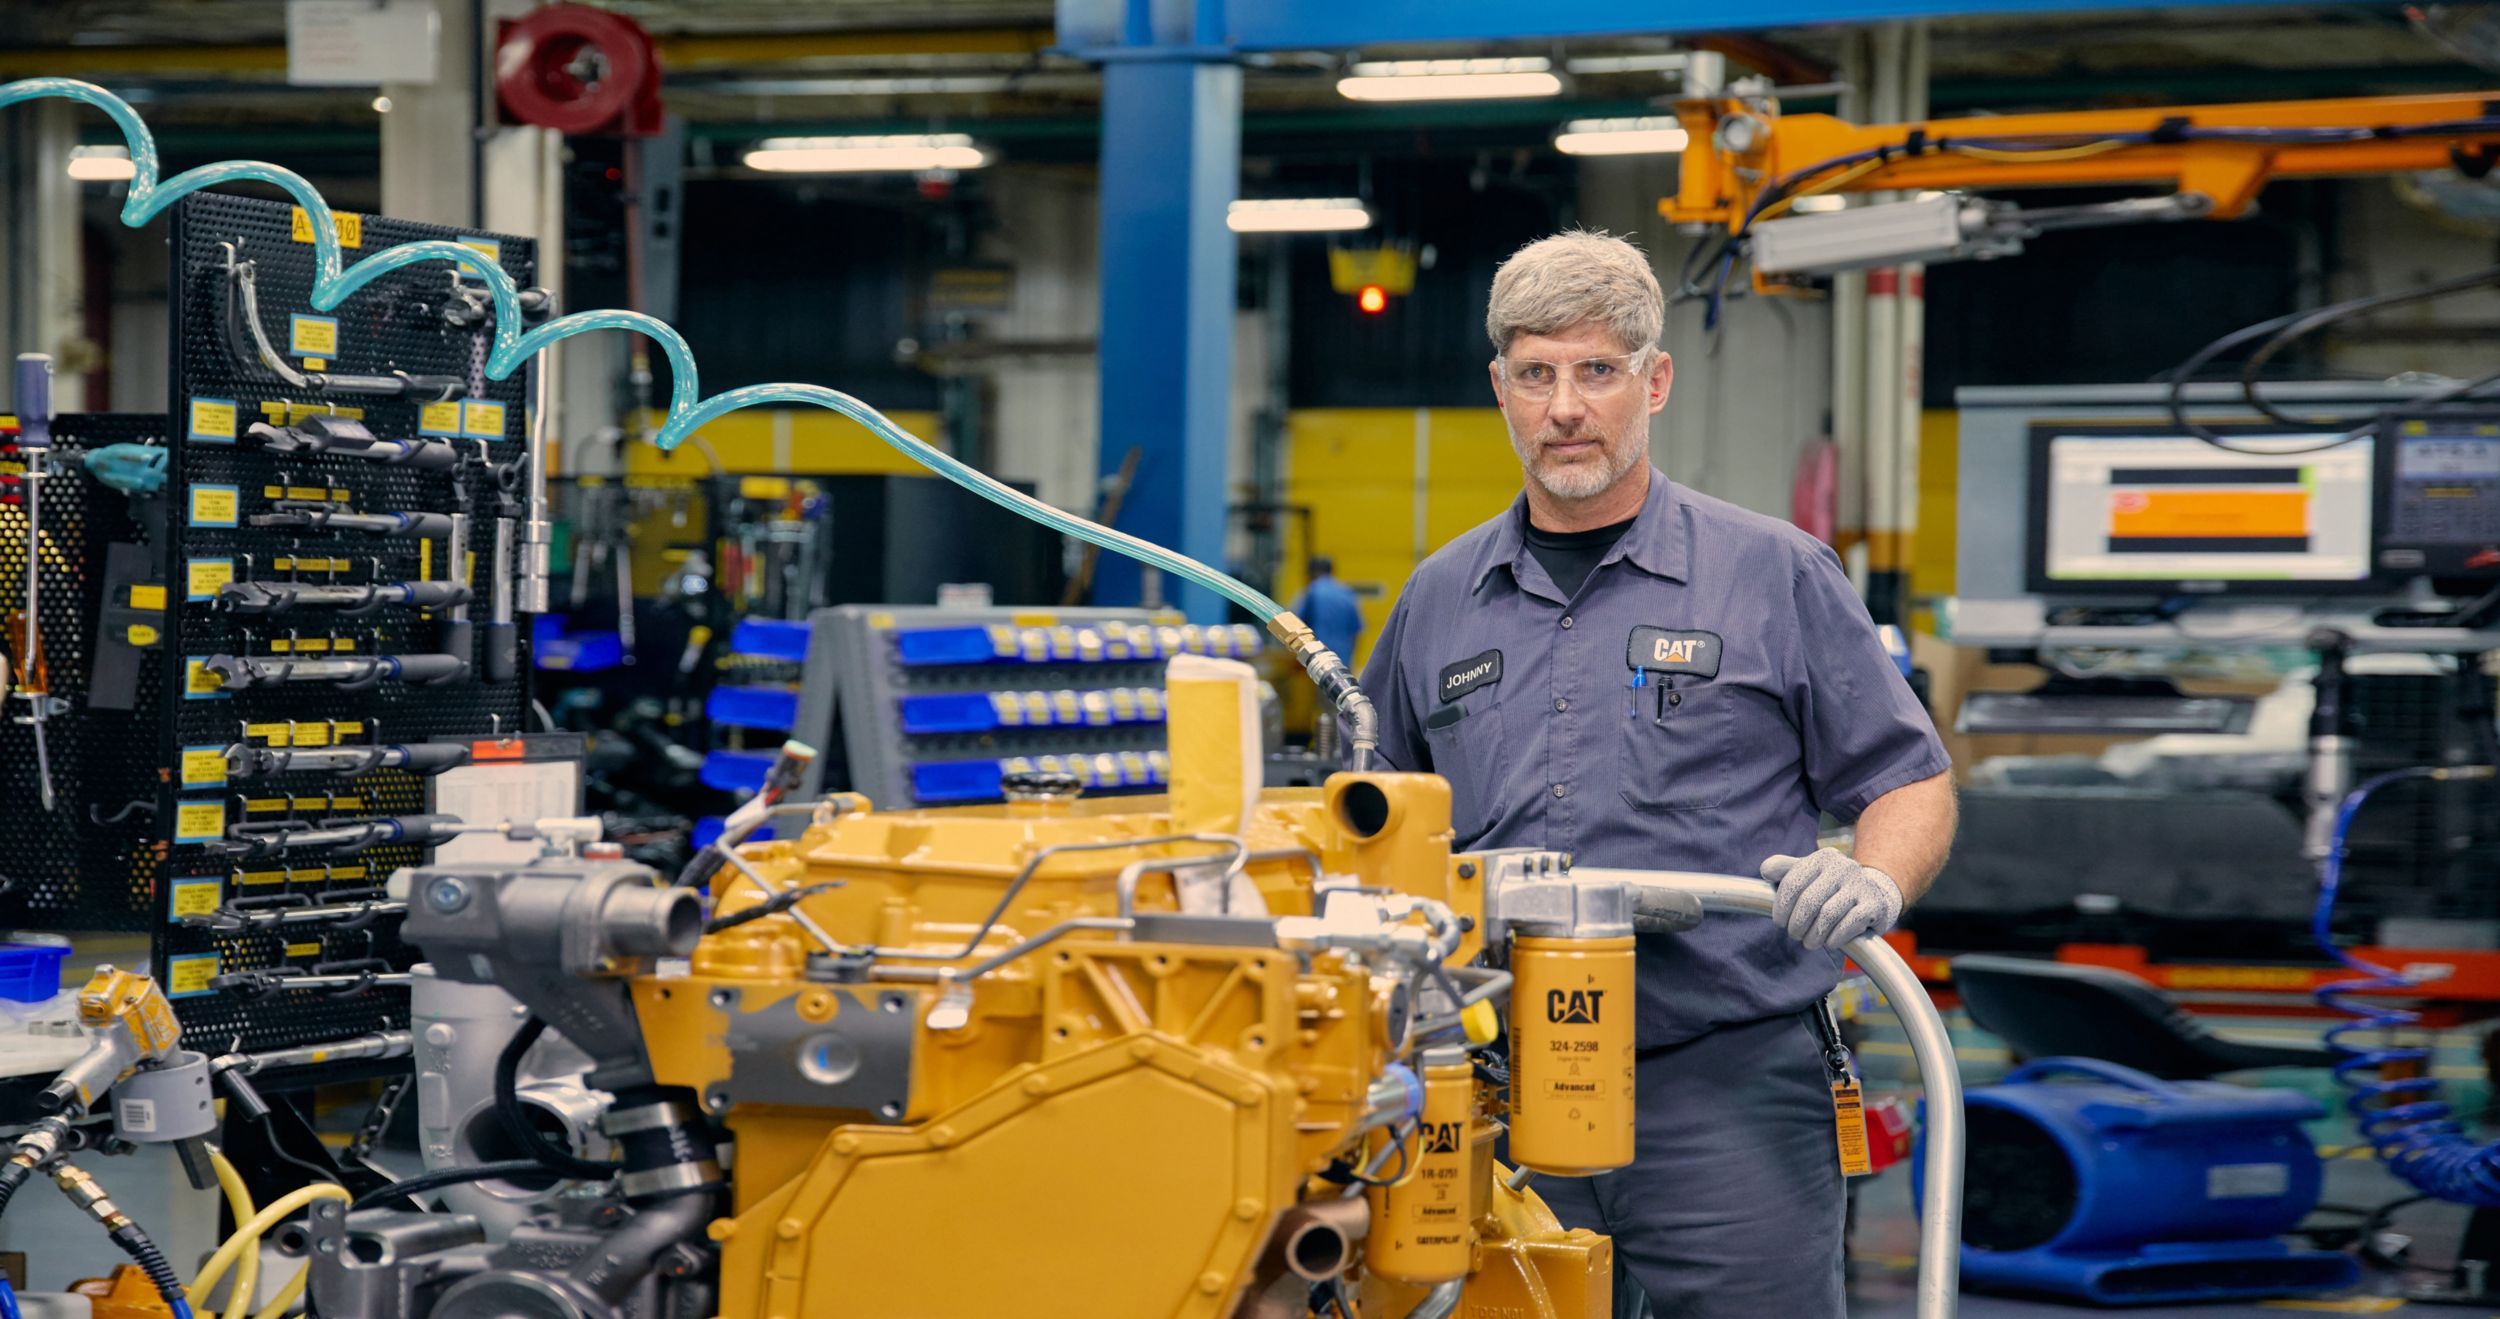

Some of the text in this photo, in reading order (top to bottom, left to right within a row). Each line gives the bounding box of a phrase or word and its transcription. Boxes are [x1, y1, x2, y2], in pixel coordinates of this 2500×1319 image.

[1446, 661, 1492, 689] JOHNNY
[1547, 989, 1604, 1024] CAT
[1550, 1041, 1599, 1052] 324-2598
[1554, 1082, 1596, 1092] Advanced
